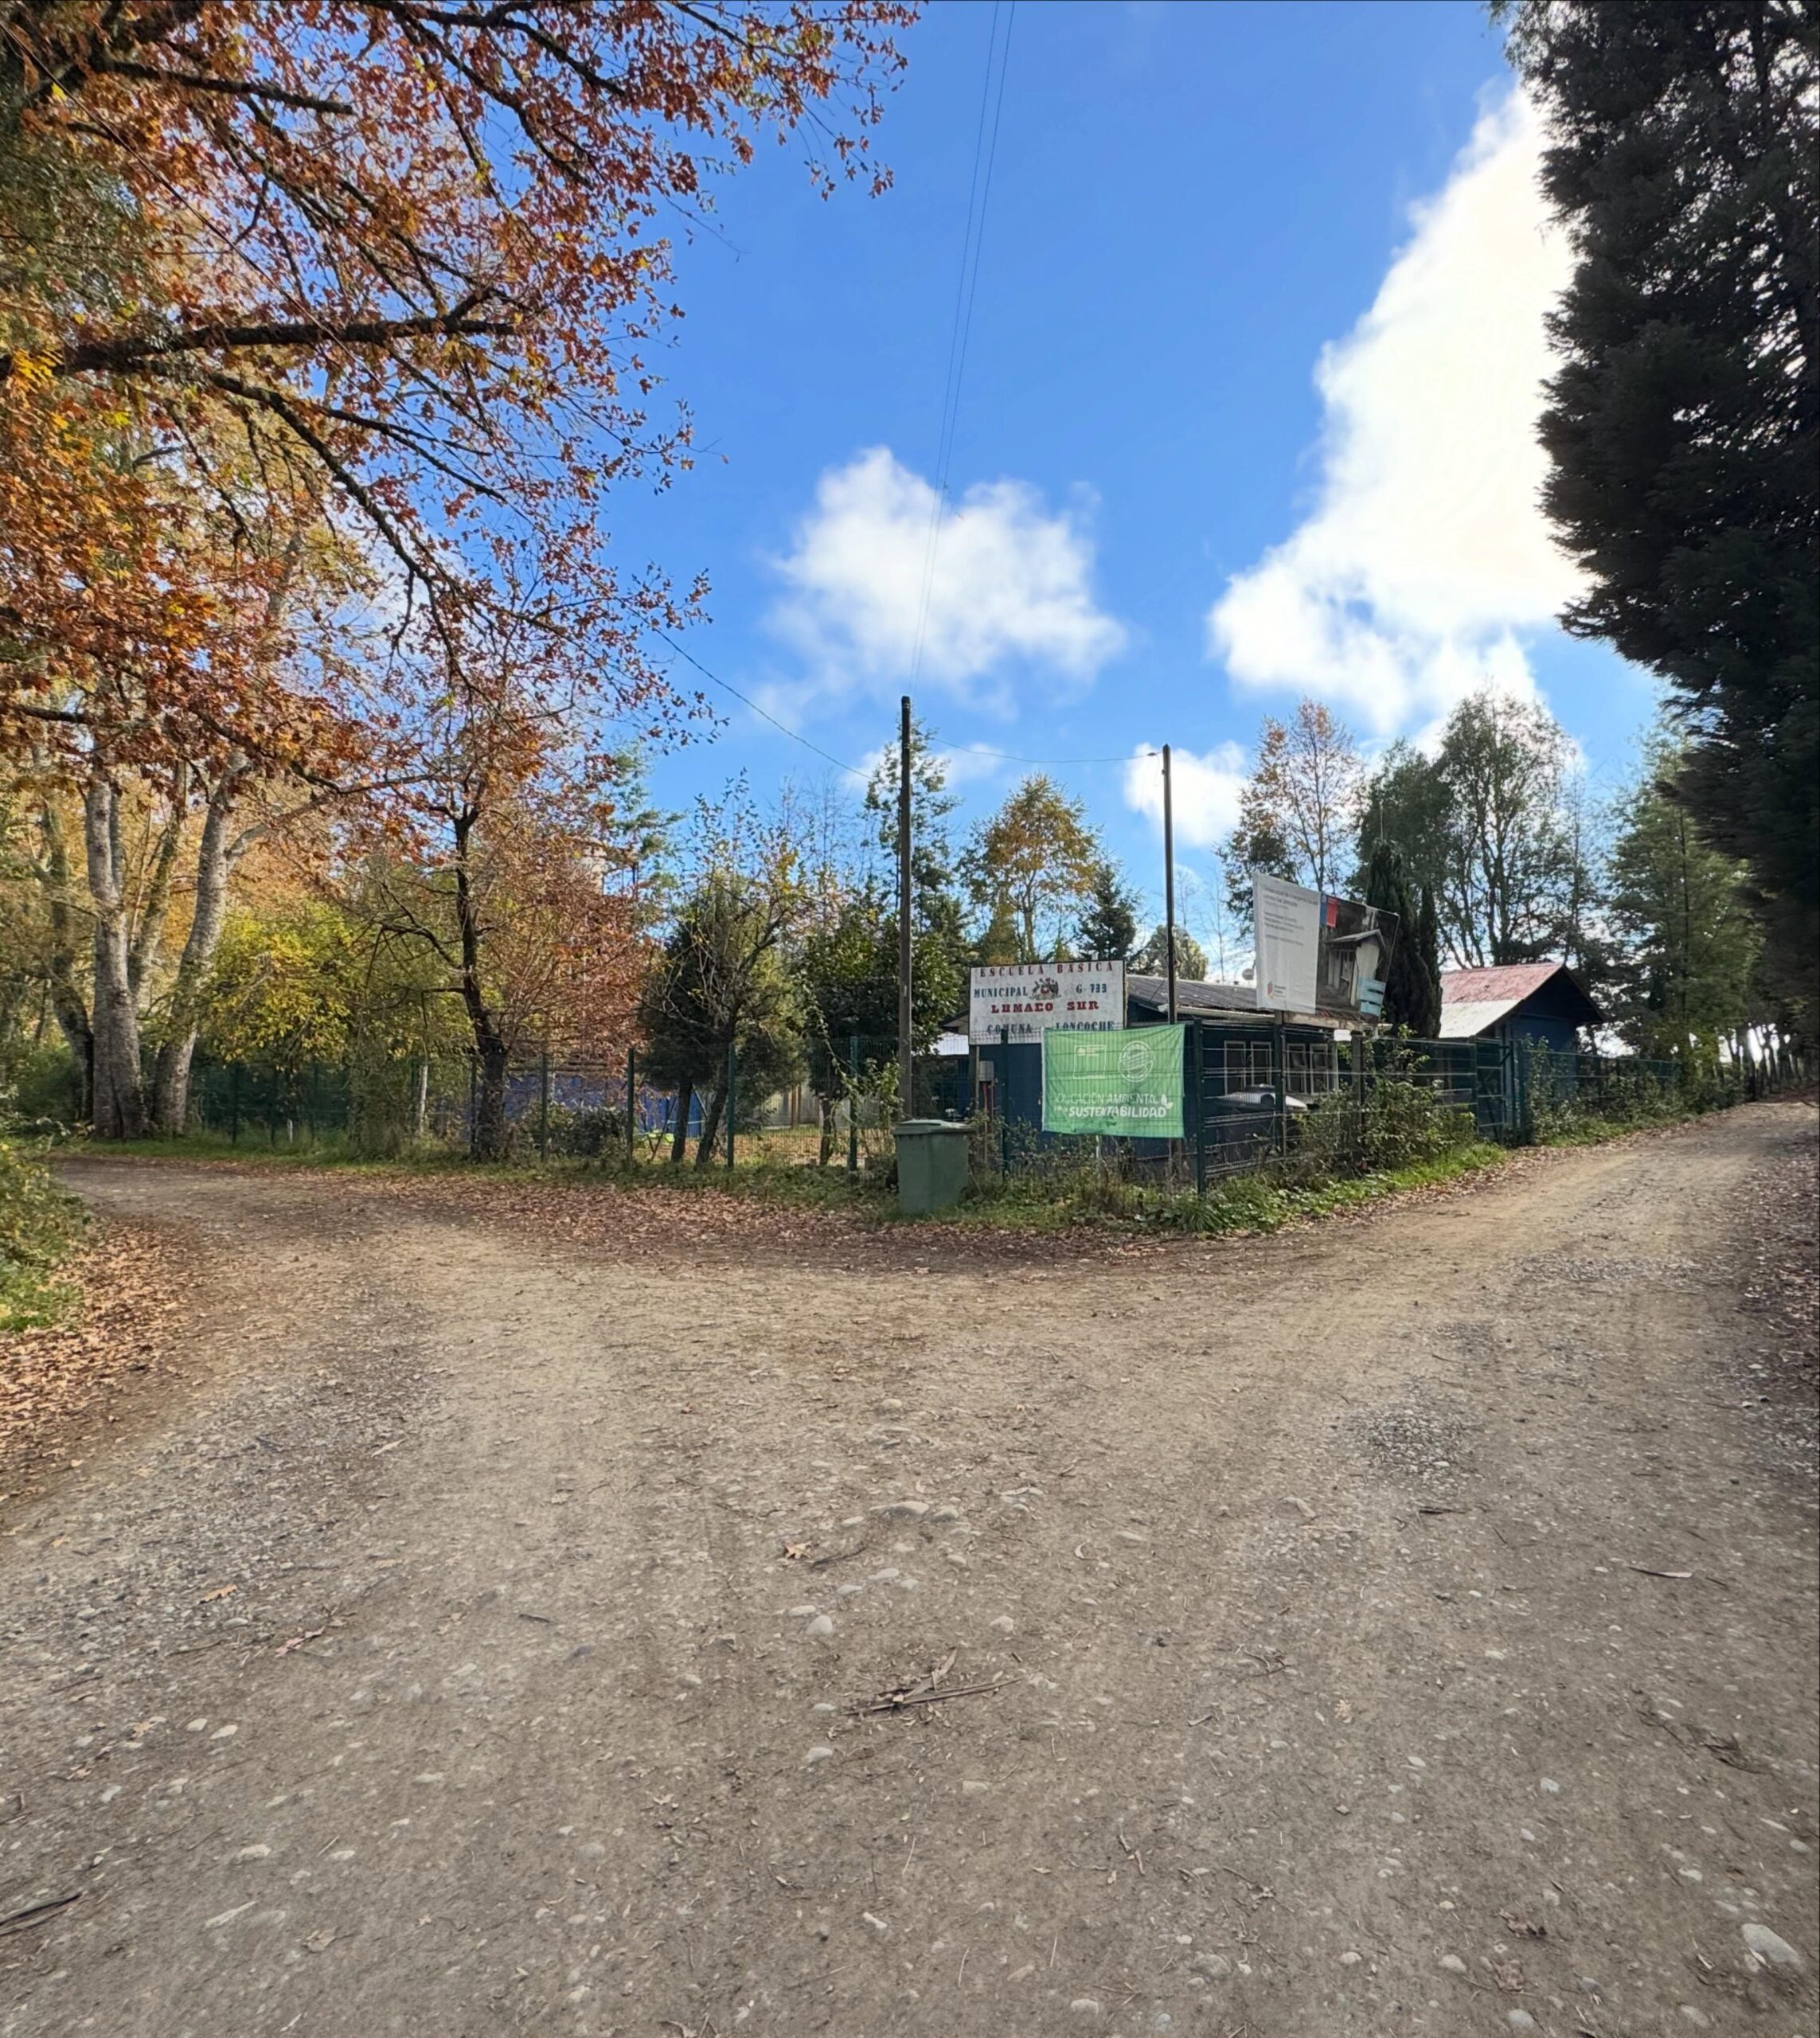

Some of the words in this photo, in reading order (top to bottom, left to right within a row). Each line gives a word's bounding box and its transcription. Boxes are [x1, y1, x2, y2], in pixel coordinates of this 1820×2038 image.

[980, 965, 1044, 978] ESCUELA
[1057, 962, 1113, 974] BASICA
[974, 986, 1028, 998] MUNICIPAL
[991, 1002, 1054, 1013] LUMACO
[1067, 1001, 1099, 1011] SUR
[1068, 1105, 1167, 1119] SUSTENTABILIDAD
